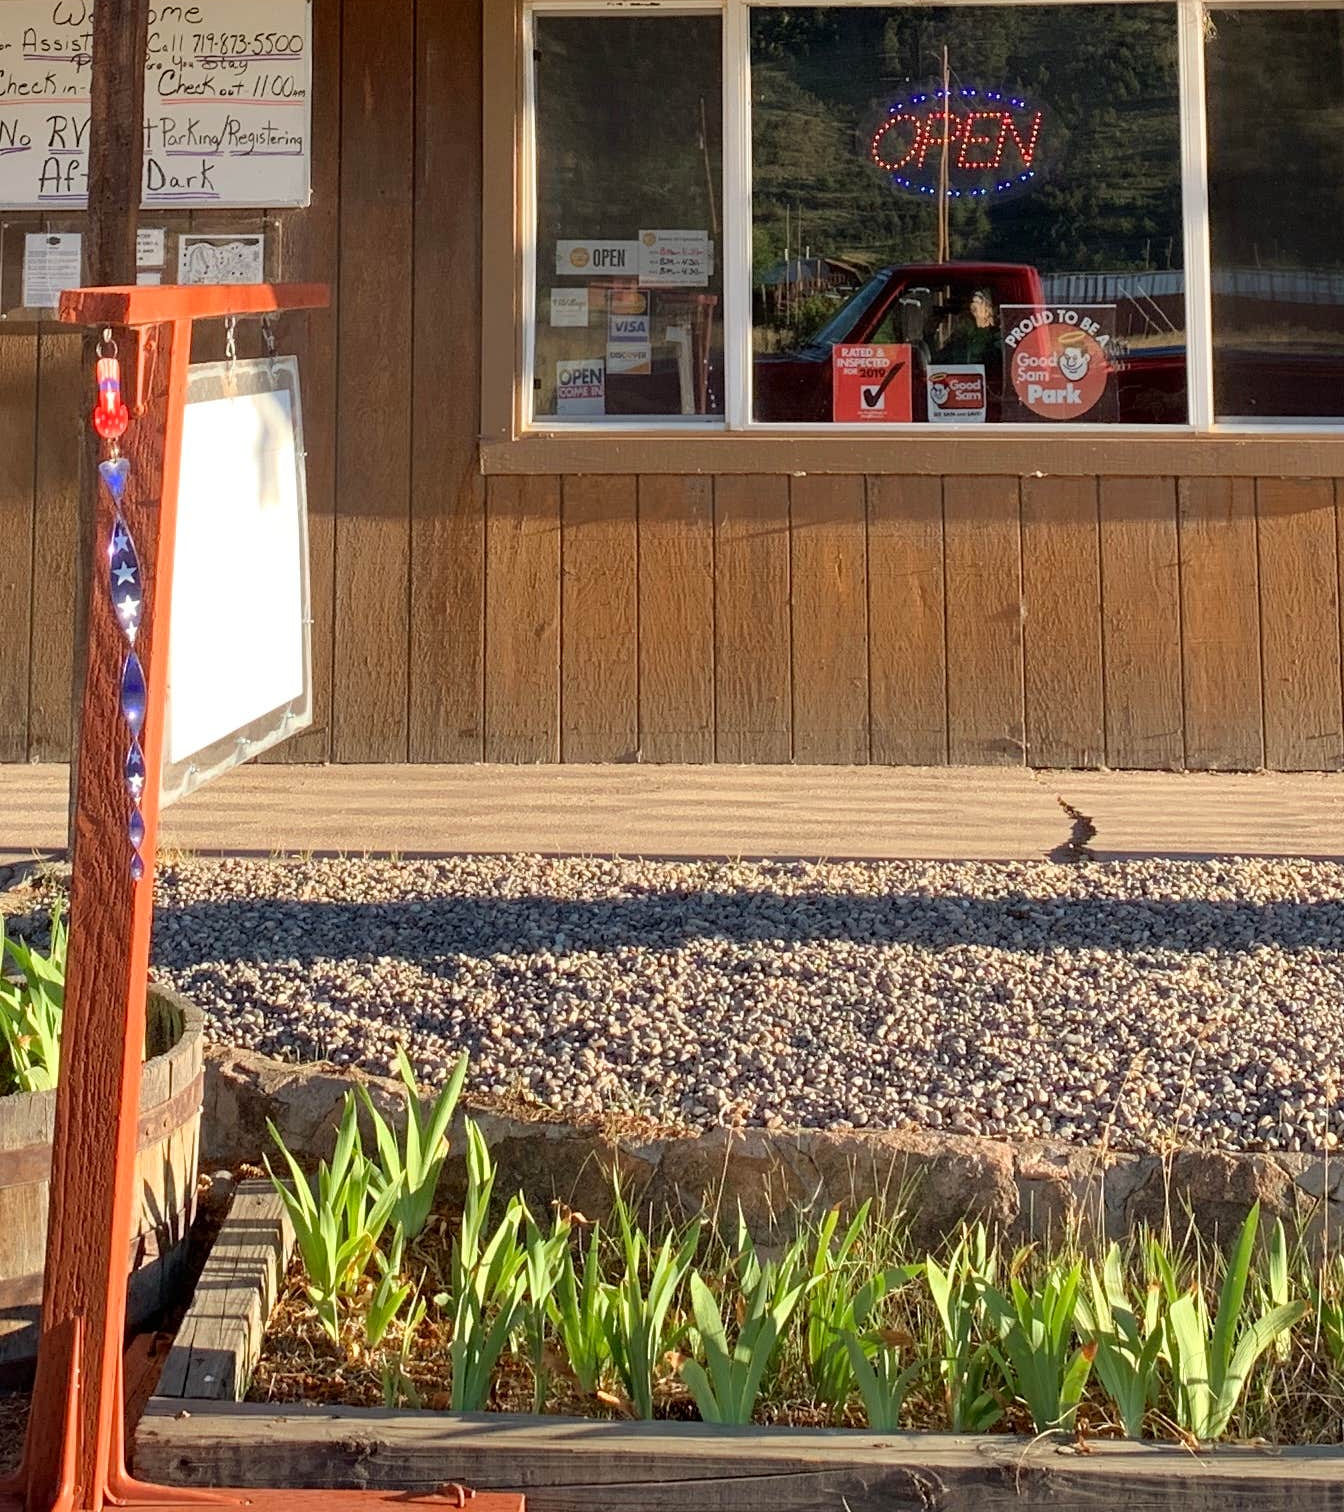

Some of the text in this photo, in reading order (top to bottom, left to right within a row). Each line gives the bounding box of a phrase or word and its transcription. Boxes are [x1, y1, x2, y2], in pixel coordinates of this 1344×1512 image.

[23, 28, 93, 52] Assist
[146, 32, 184, 53] Call
[871, 112, 1040, 168] OPEN
[146, 158, 214, 191] Dark
[593, 249, 625, 267] OPEN
[616, 321, 646, 333] VISA
[1005, 309, 1110, 348] PROUD TO BE A
[842, 348, 872, 357] RATED
[1017, 352, 1057, 367] Good
[837, 358, 890, 367] INSPECTED
[559, 368, 602, 385] OPEN
[860, 367, 886, 378] 2019
[1017, 367, 1049, 382] Sam
[950, 379, 981, 390] Good
[955, 391, 982, 400] Sam
[1027, 382, 1082, 404] Park
